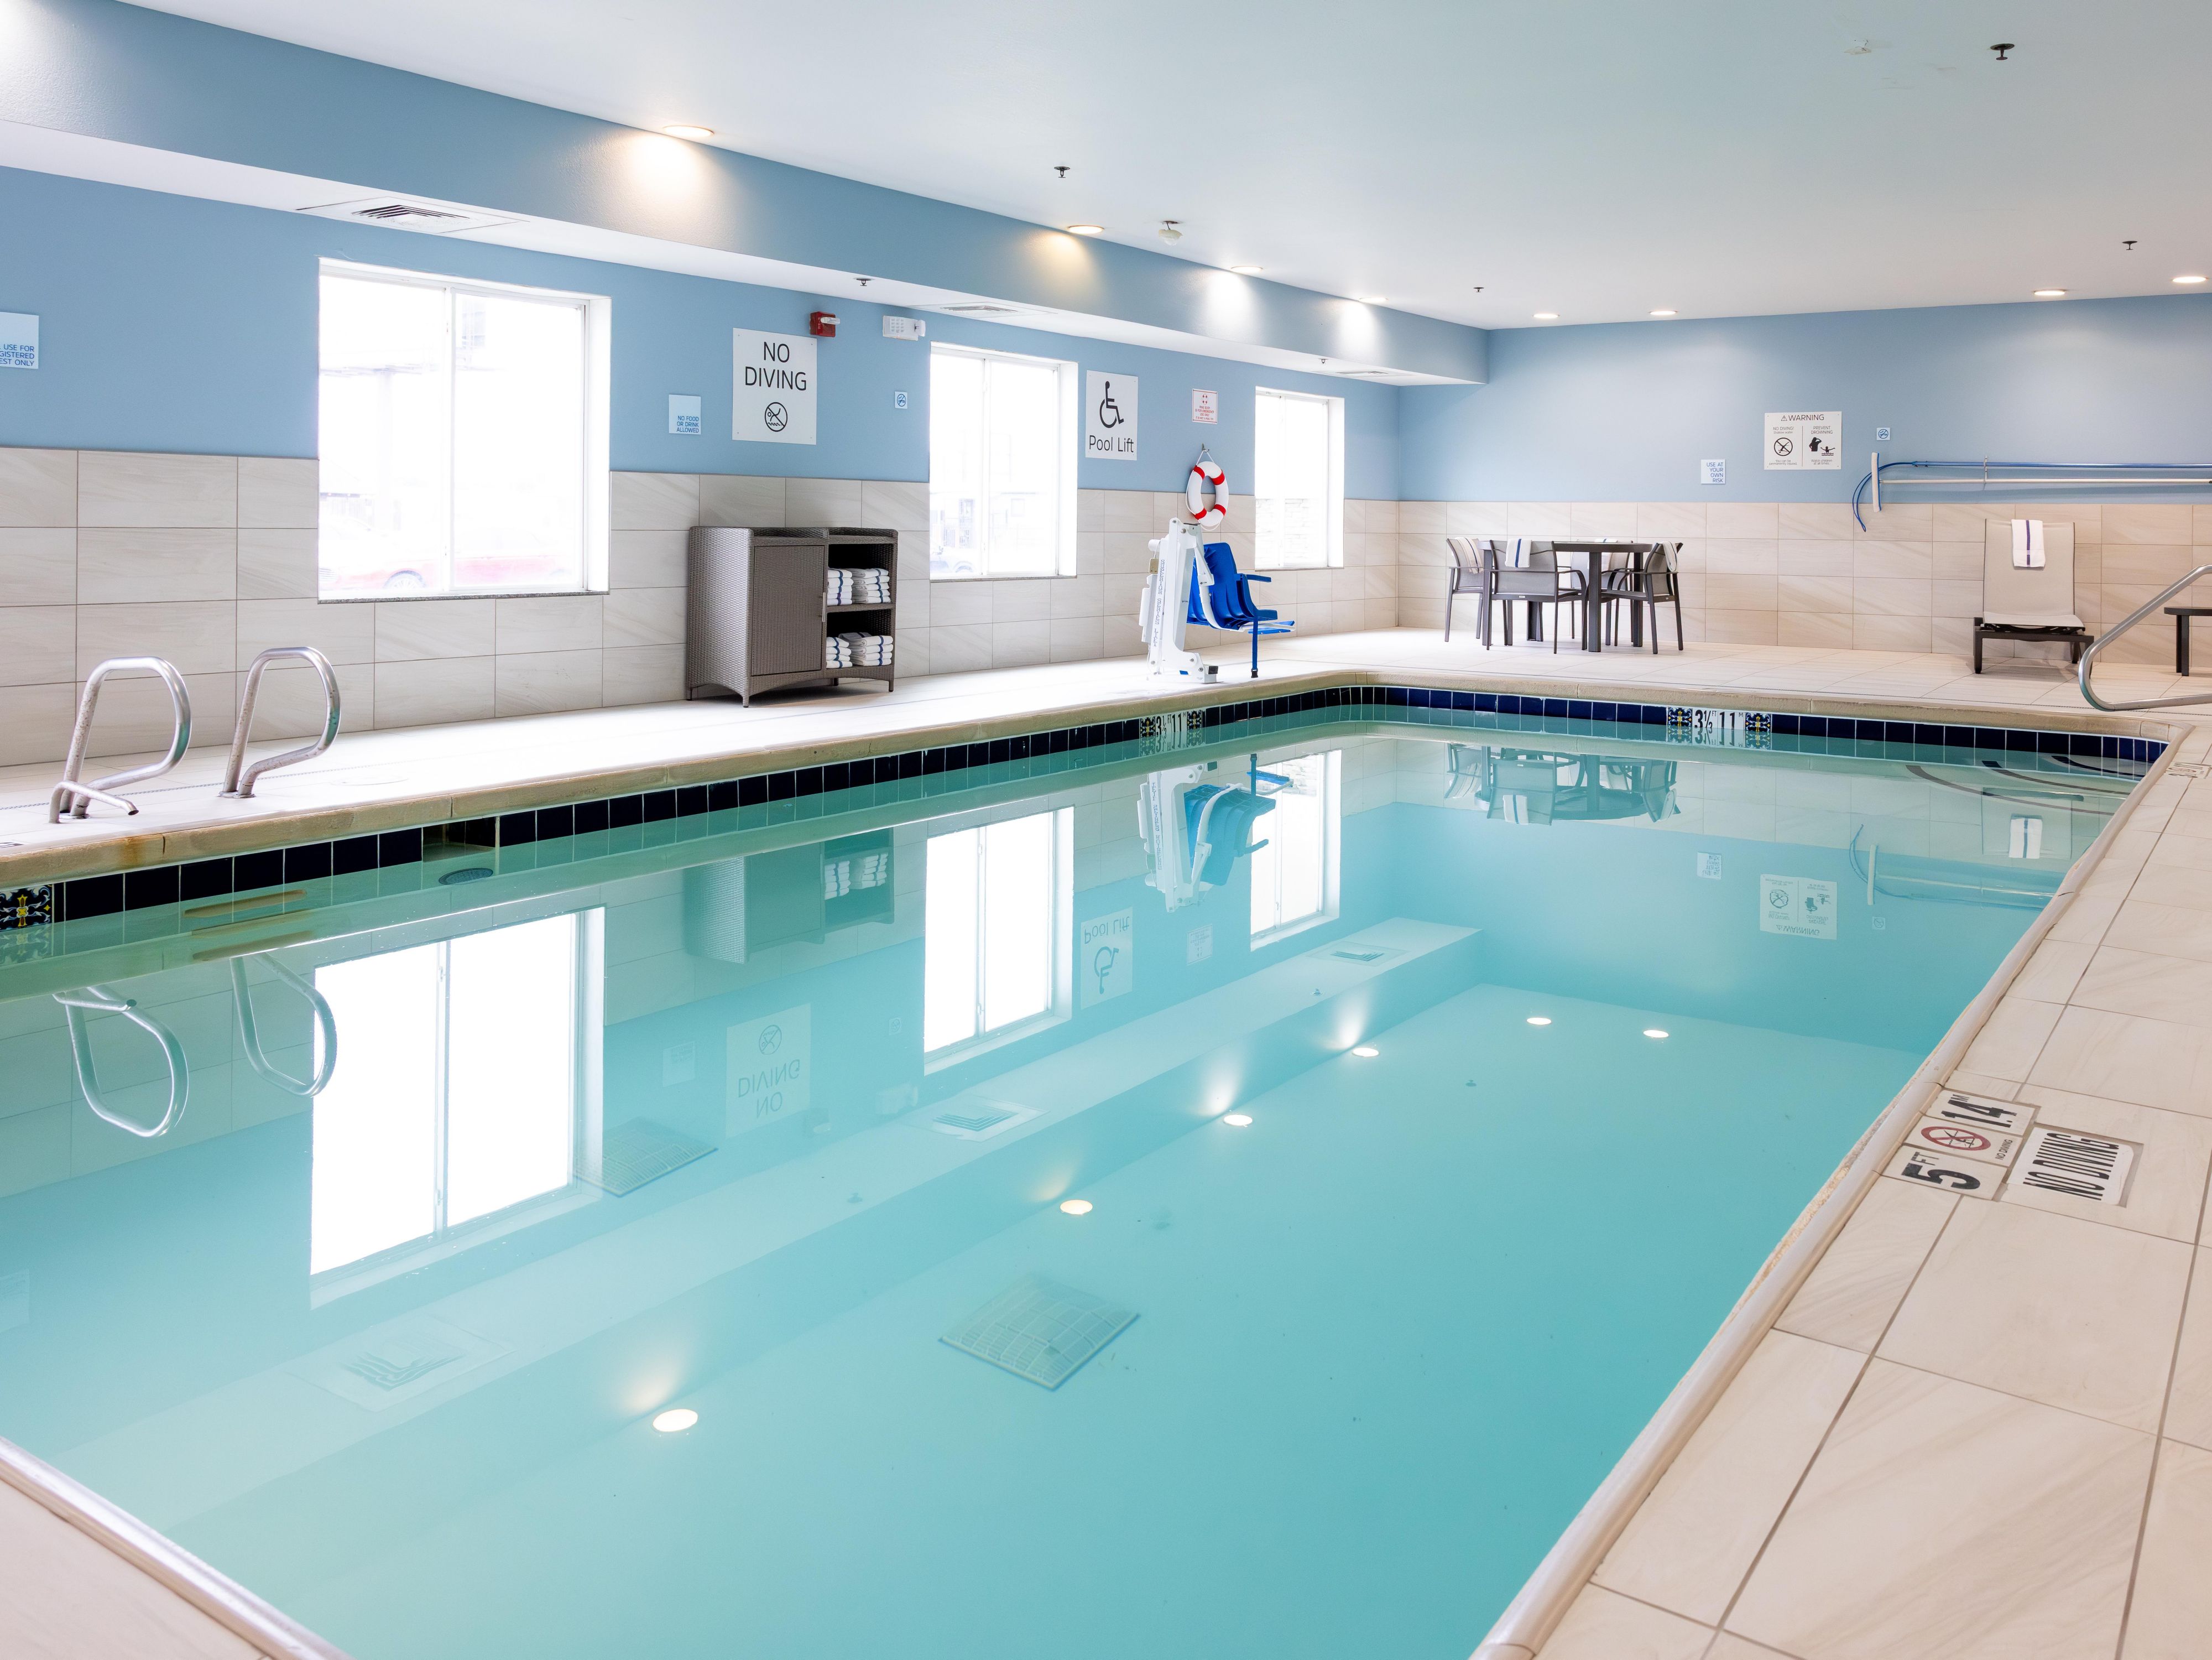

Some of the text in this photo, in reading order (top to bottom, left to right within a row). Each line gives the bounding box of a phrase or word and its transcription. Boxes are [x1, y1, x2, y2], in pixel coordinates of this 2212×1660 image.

[764, 341, 790, 363] NO
[745, 366, 807, 391] DIVING
[1089, 435, 1134, 452] Pool Lift
[1156, 716, 1162, 735] 3
[1168, 714, 1171, 724] FT
[1694, 709, 1703, 728] 3
[1941, 1094, 2018, 1128] 1.4 M
[1995, 1139, 2013, 1161] NO DIVING
[1901, 1151, 1981, 1190] 5 FT
[2023, 1132, 2120, 1201] NO DIVING
